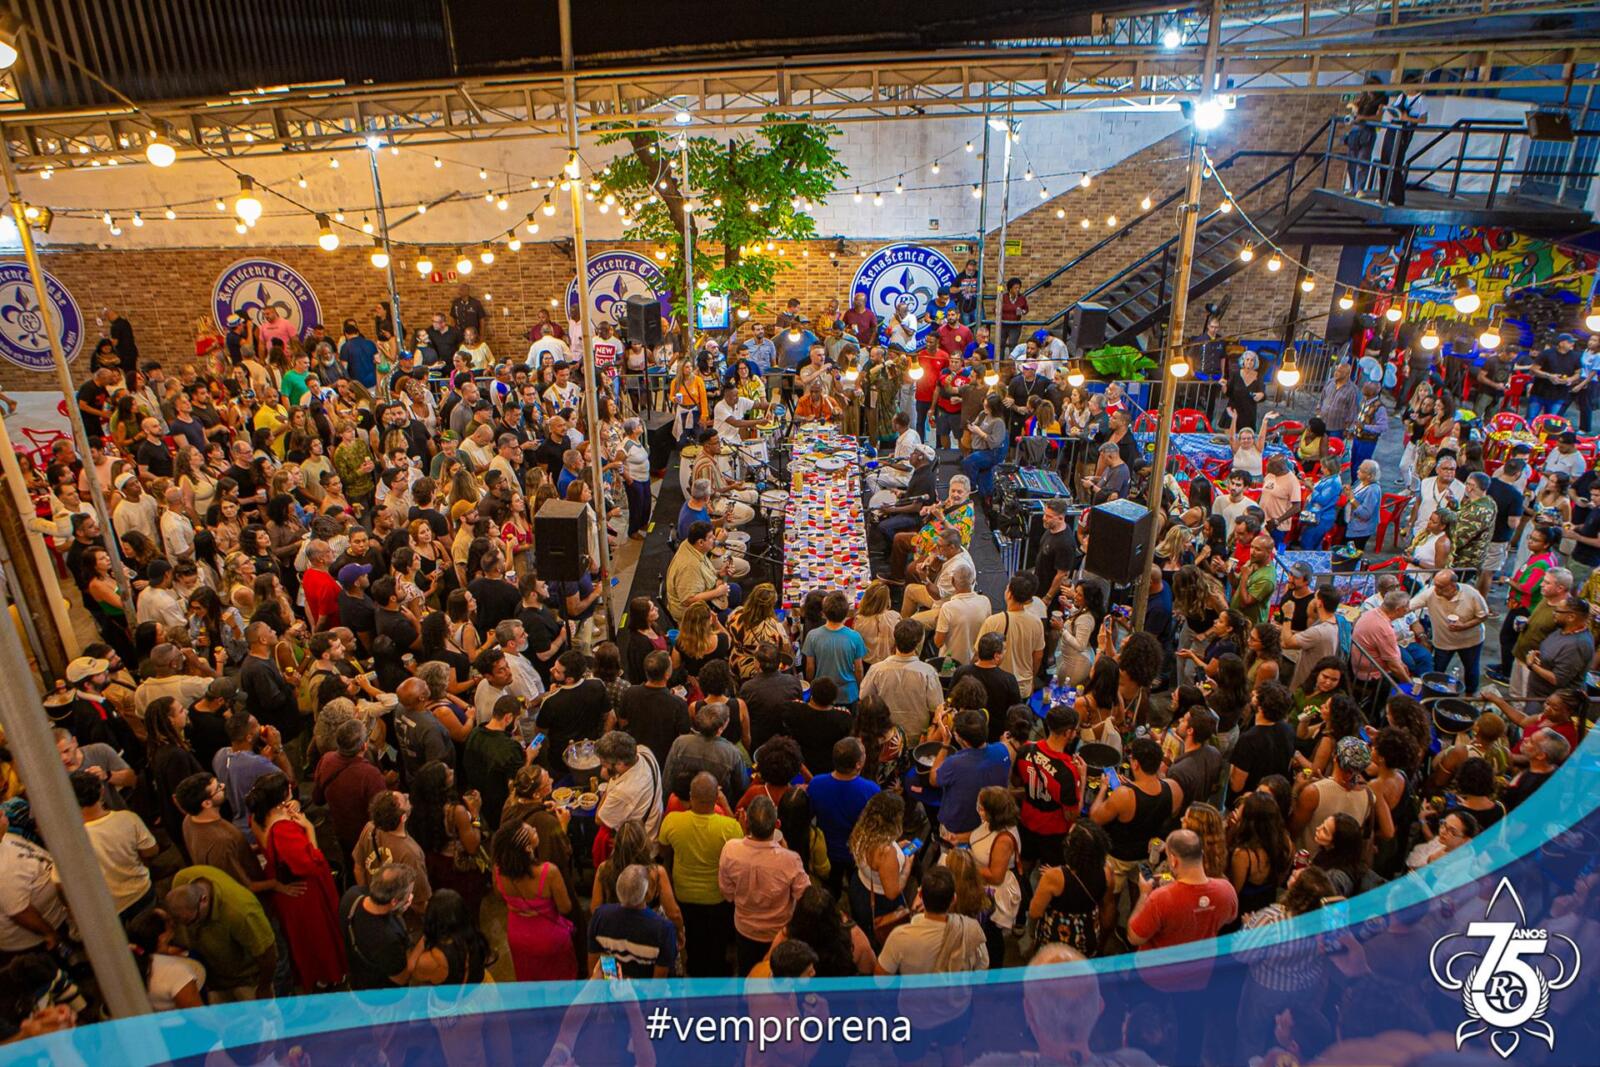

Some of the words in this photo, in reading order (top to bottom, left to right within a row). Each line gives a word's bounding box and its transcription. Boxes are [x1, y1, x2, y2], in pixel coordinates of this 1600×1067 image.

[216, 265, 275, 305] Renascença
[277, 269, 308, 303] Clube
[858, 250, 925, 289] Renascença
[926, 254, 953, 288] Clube
[595, 346, 613, 355] NEW
